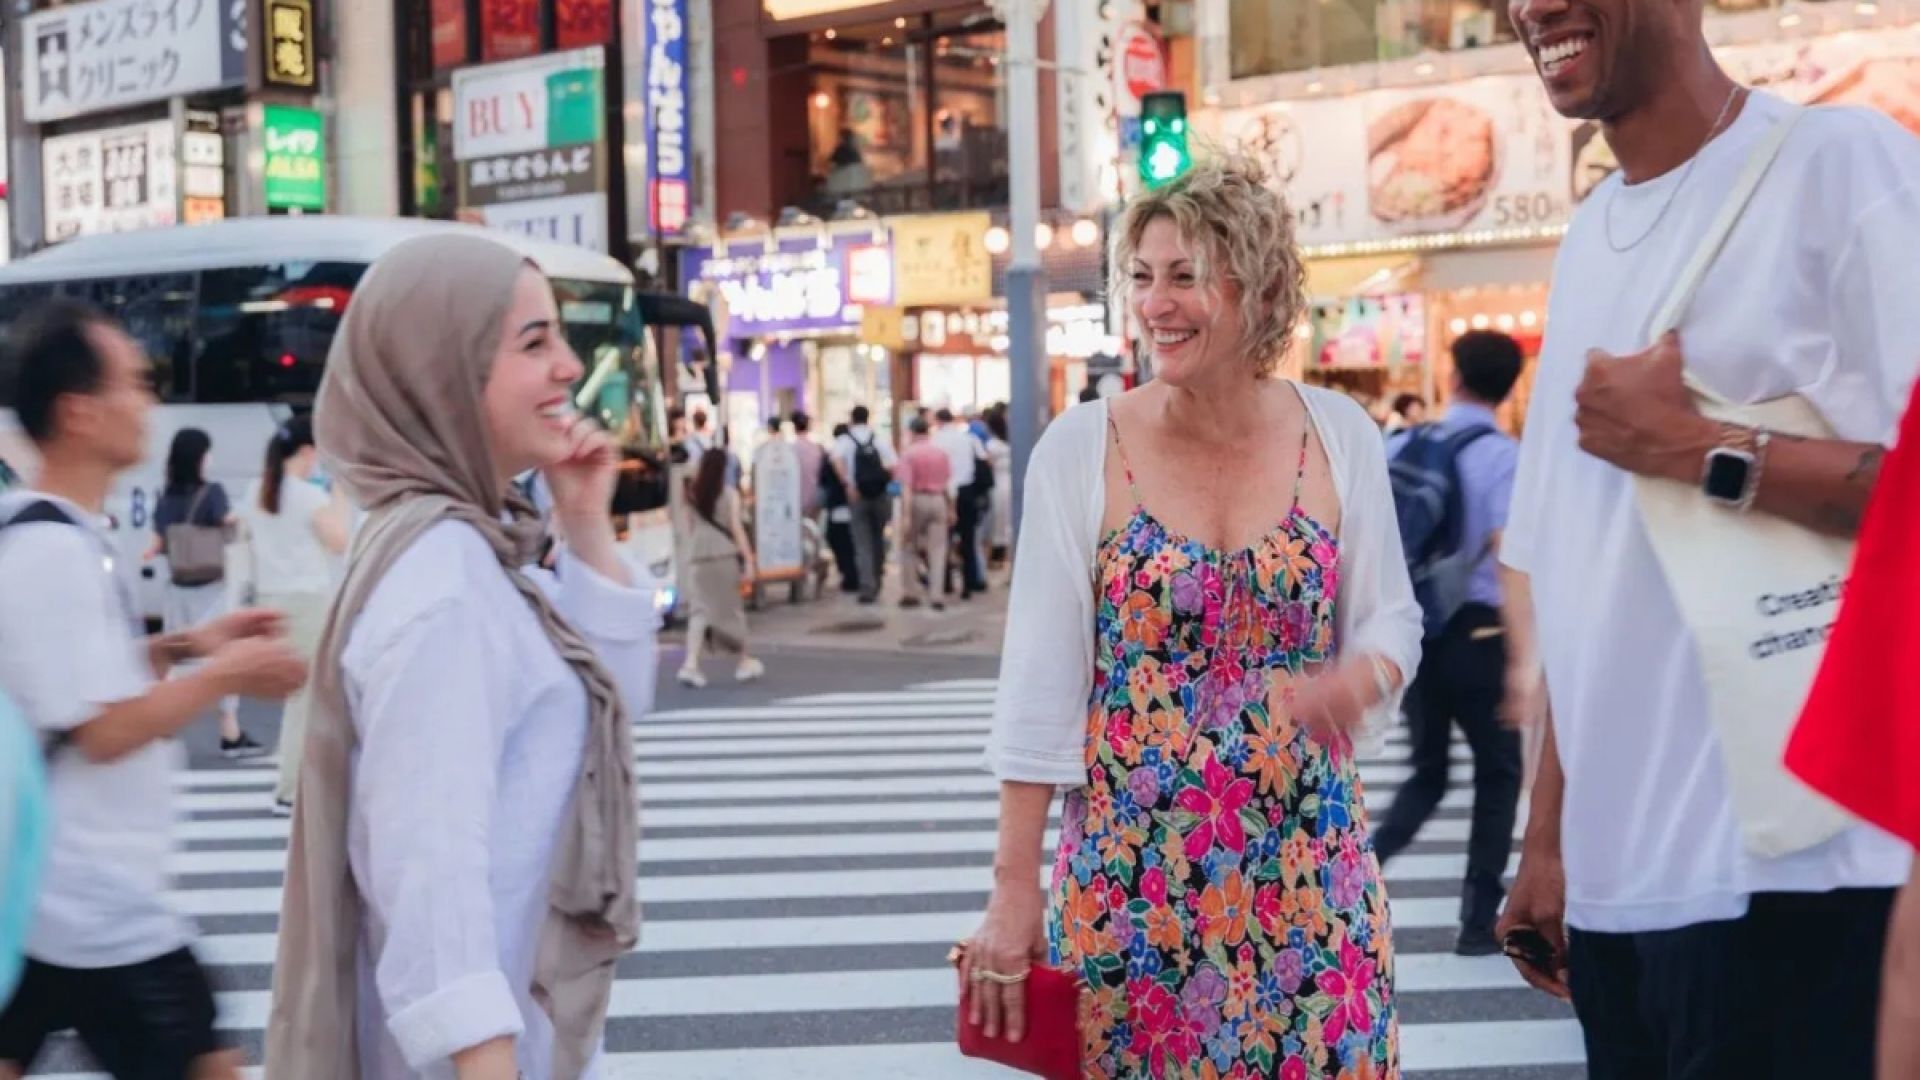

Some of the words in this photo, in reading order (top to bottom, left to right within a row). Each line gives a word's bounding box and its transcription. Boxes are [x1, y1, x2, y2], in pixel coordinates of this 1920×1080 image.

[78, 48, 180, 98] クリニック
[468, 91, 534, 138] BUY
[1748, 625, 1834, 660] chan
